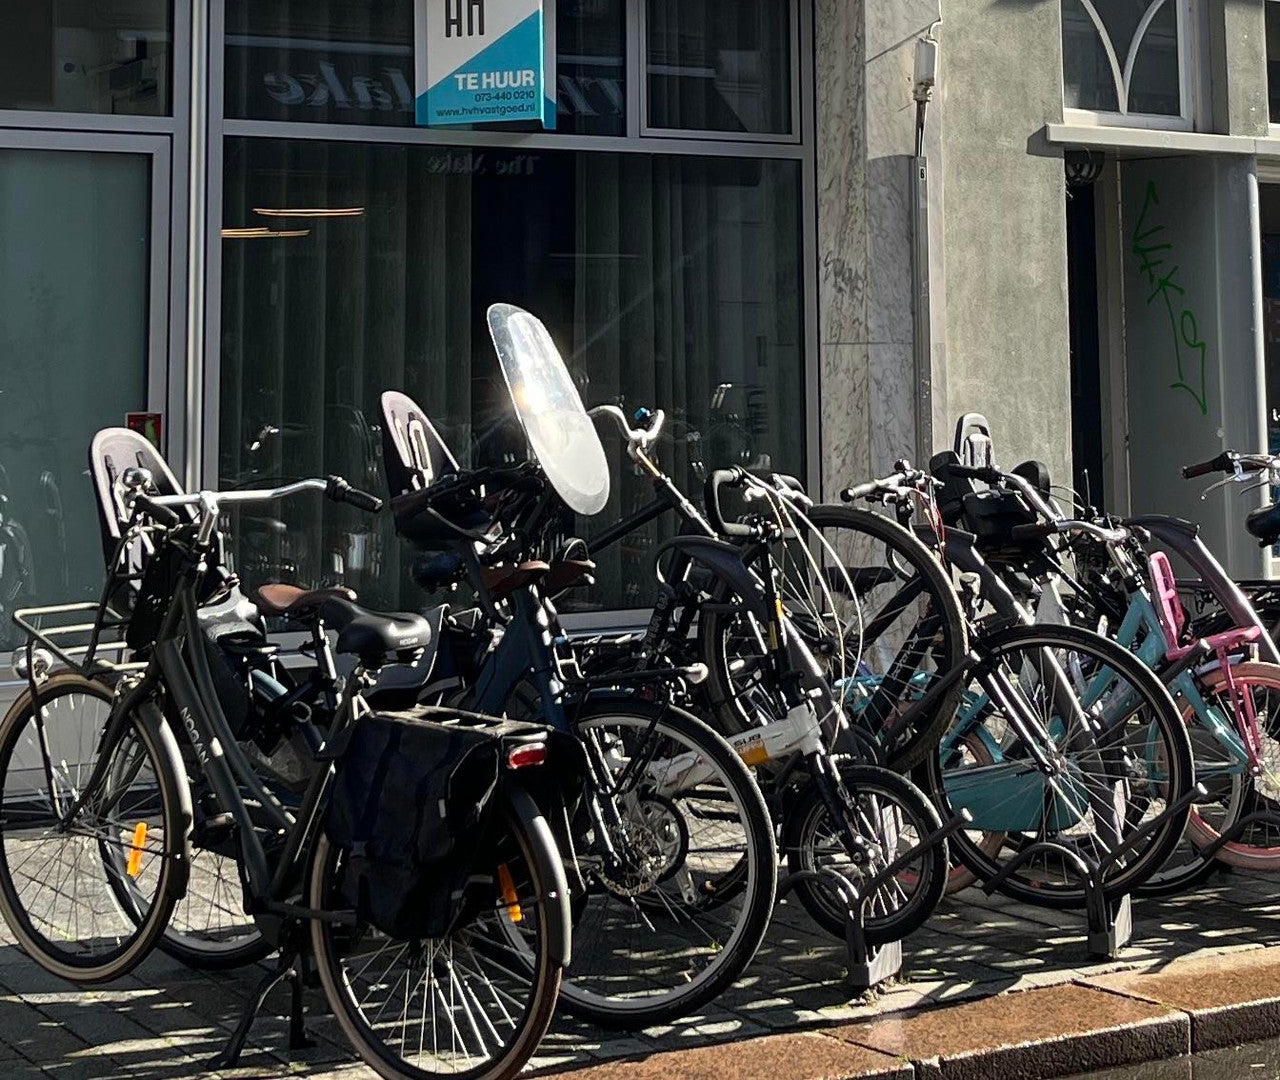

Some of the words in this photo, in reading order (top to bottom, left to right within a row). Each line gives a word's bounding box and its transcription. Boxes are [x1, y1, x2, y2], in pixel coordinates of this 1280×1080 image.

[454, 73, 478, 91] TE
[482, 70, 535, 89] HUUR
[474, 92, 512, 102] 073-440
[514, 90, 535, 99] 0210
[436, 104, 535, 117] www.hvhvastgoed.nl
